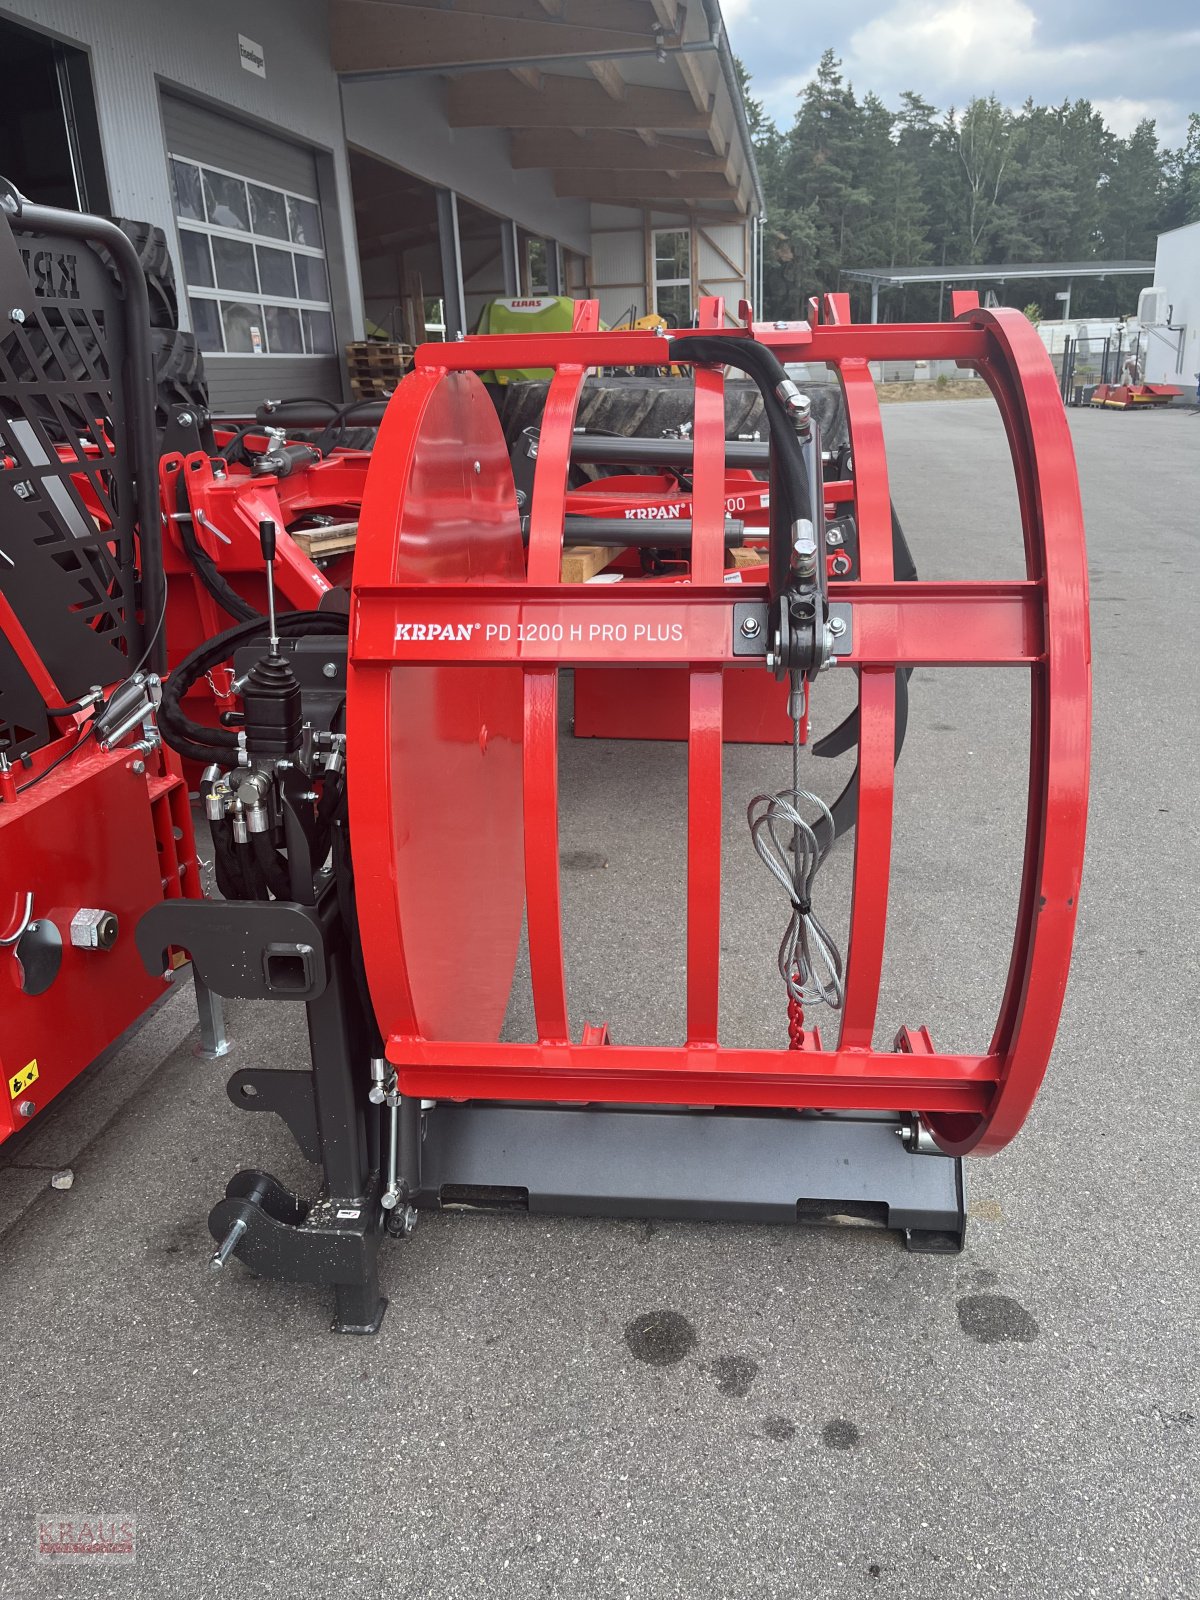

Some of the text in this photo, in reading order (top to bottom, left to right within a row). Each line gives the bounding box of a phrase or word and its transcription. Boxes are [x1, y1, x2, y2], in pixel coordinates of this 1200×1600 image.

[485, 624, 511, 641] PD
[517, 624, 563, 641] 1200
[570, 624, 582, 641] H
[589, 624, 627, 641] PRO
[634, 624, 683, 641] PLUS
